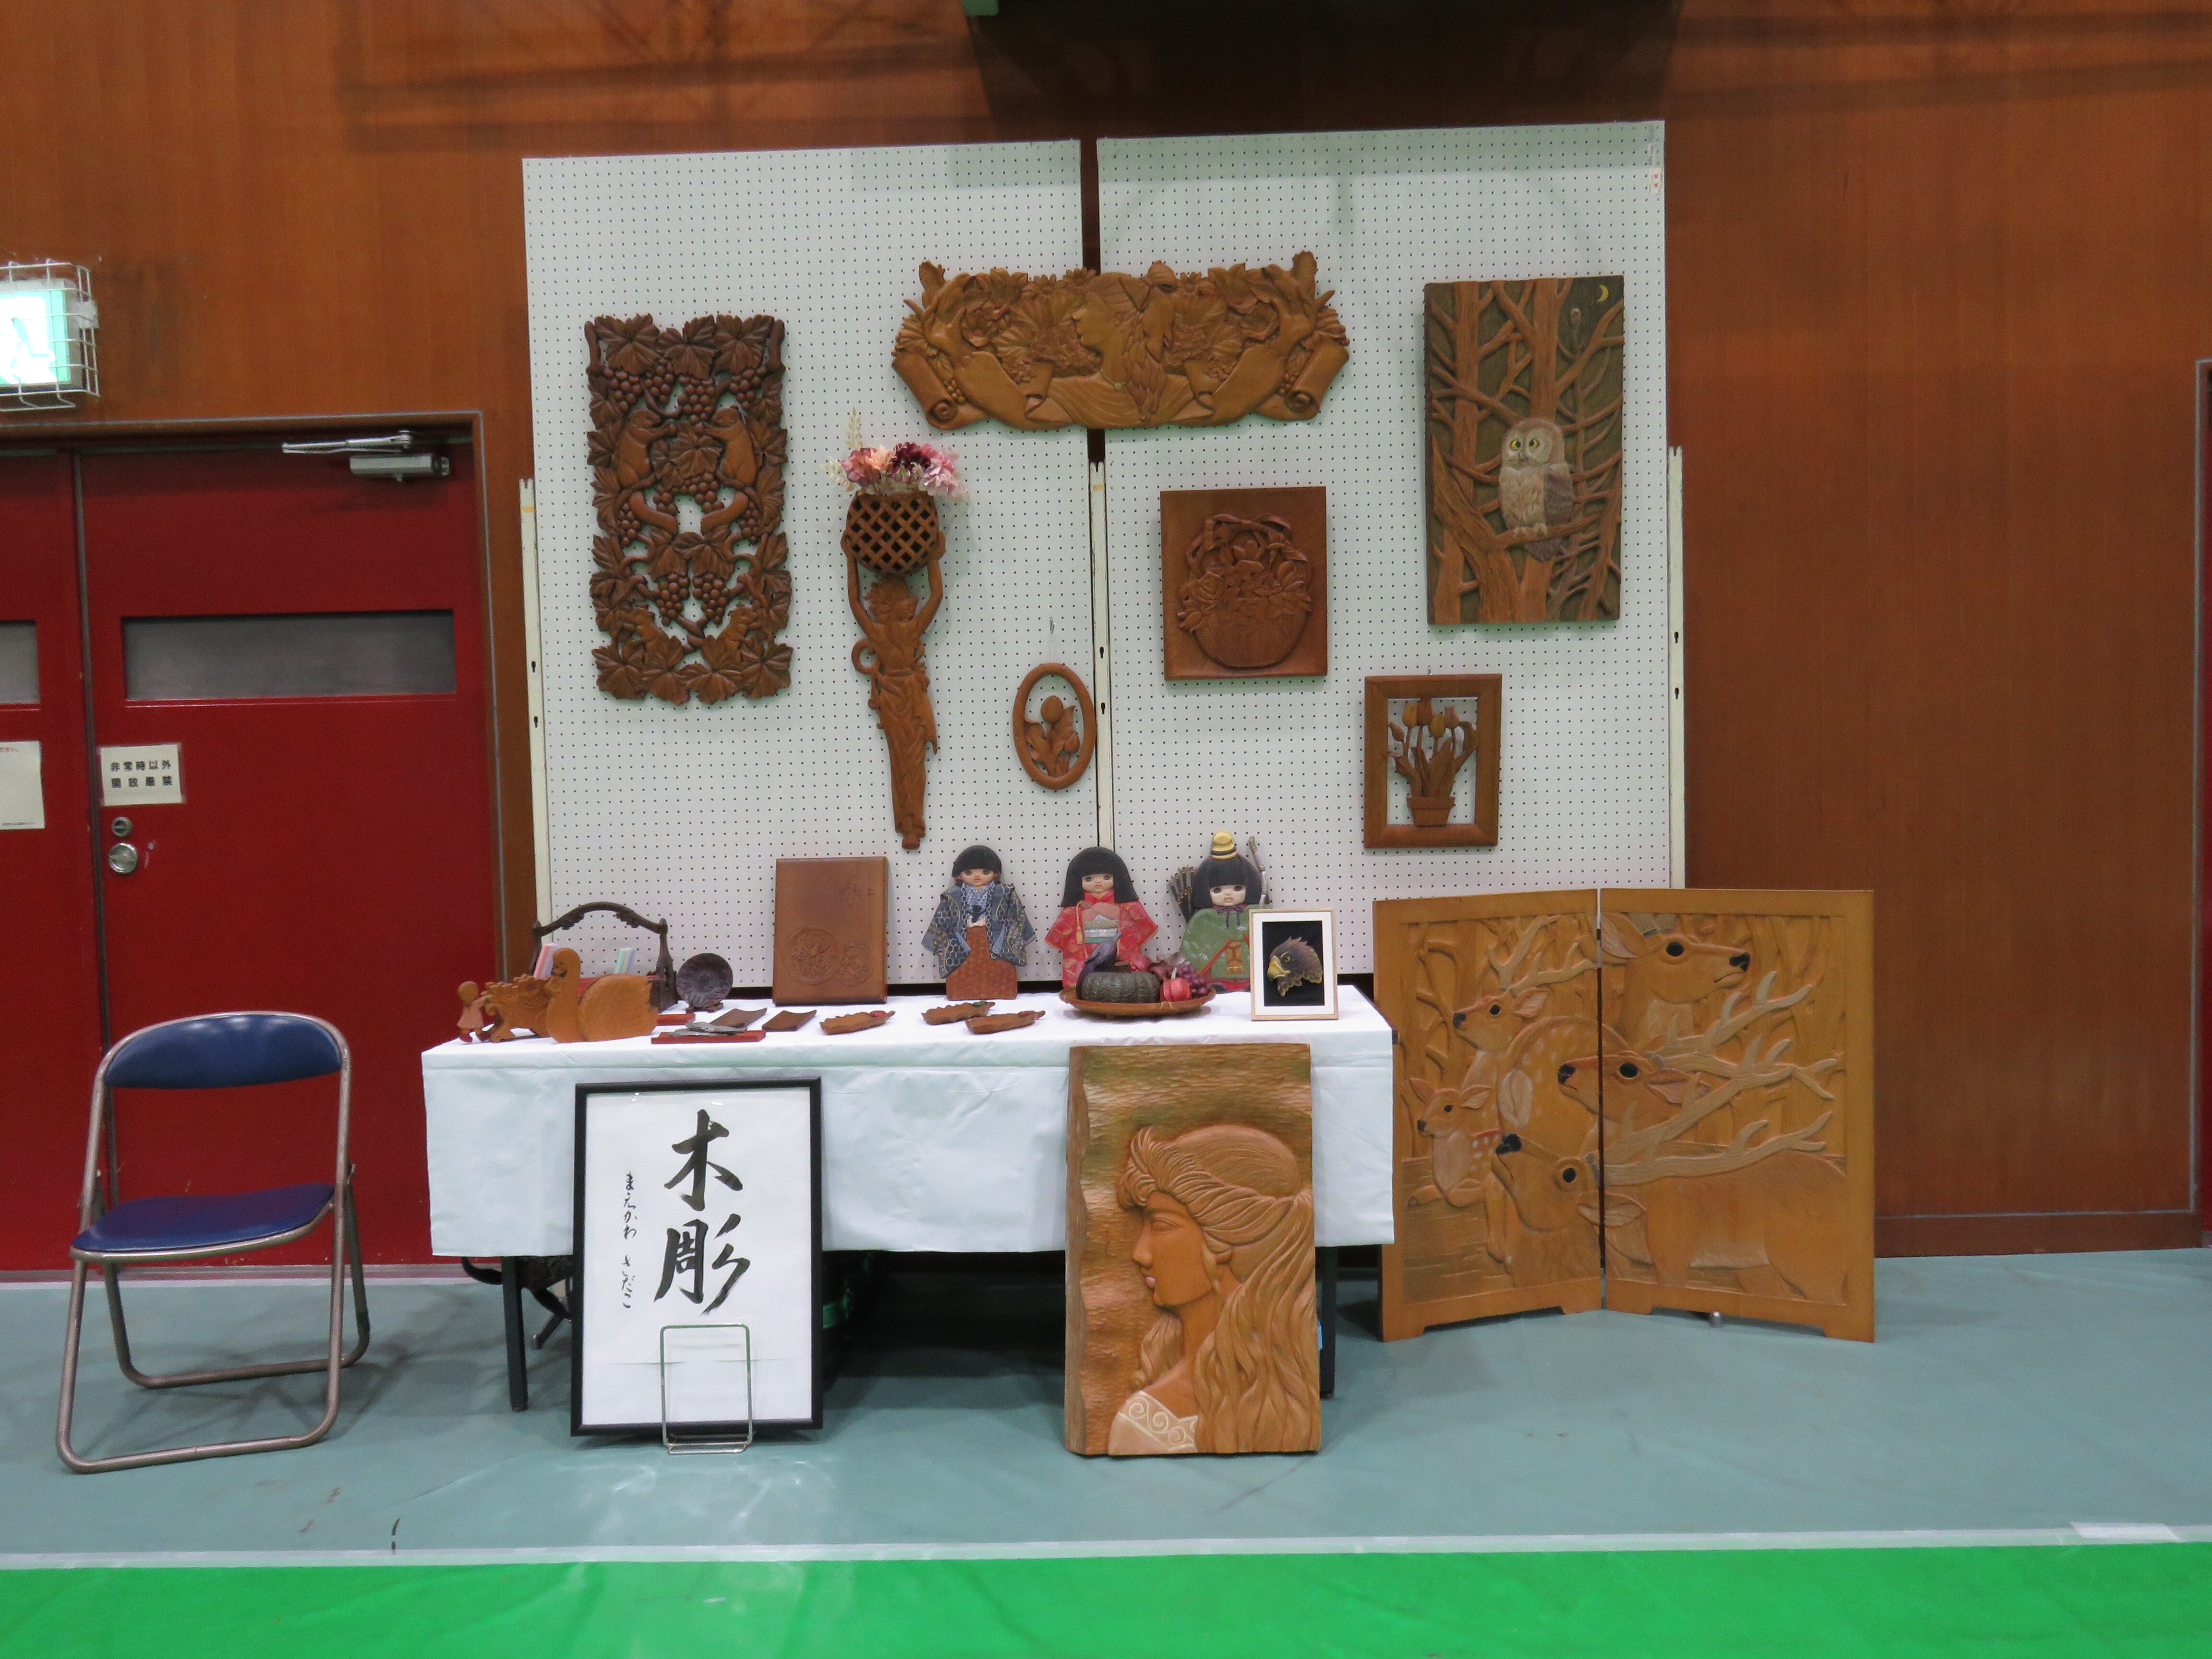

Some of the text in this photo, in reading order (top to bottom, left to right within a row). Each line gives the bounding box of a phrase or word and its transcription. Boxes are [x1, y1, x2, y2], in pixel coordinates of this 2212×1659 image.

[110, 759, 171, 772] 非常時以外
[653, 1109, 750, 1316] 木彫
